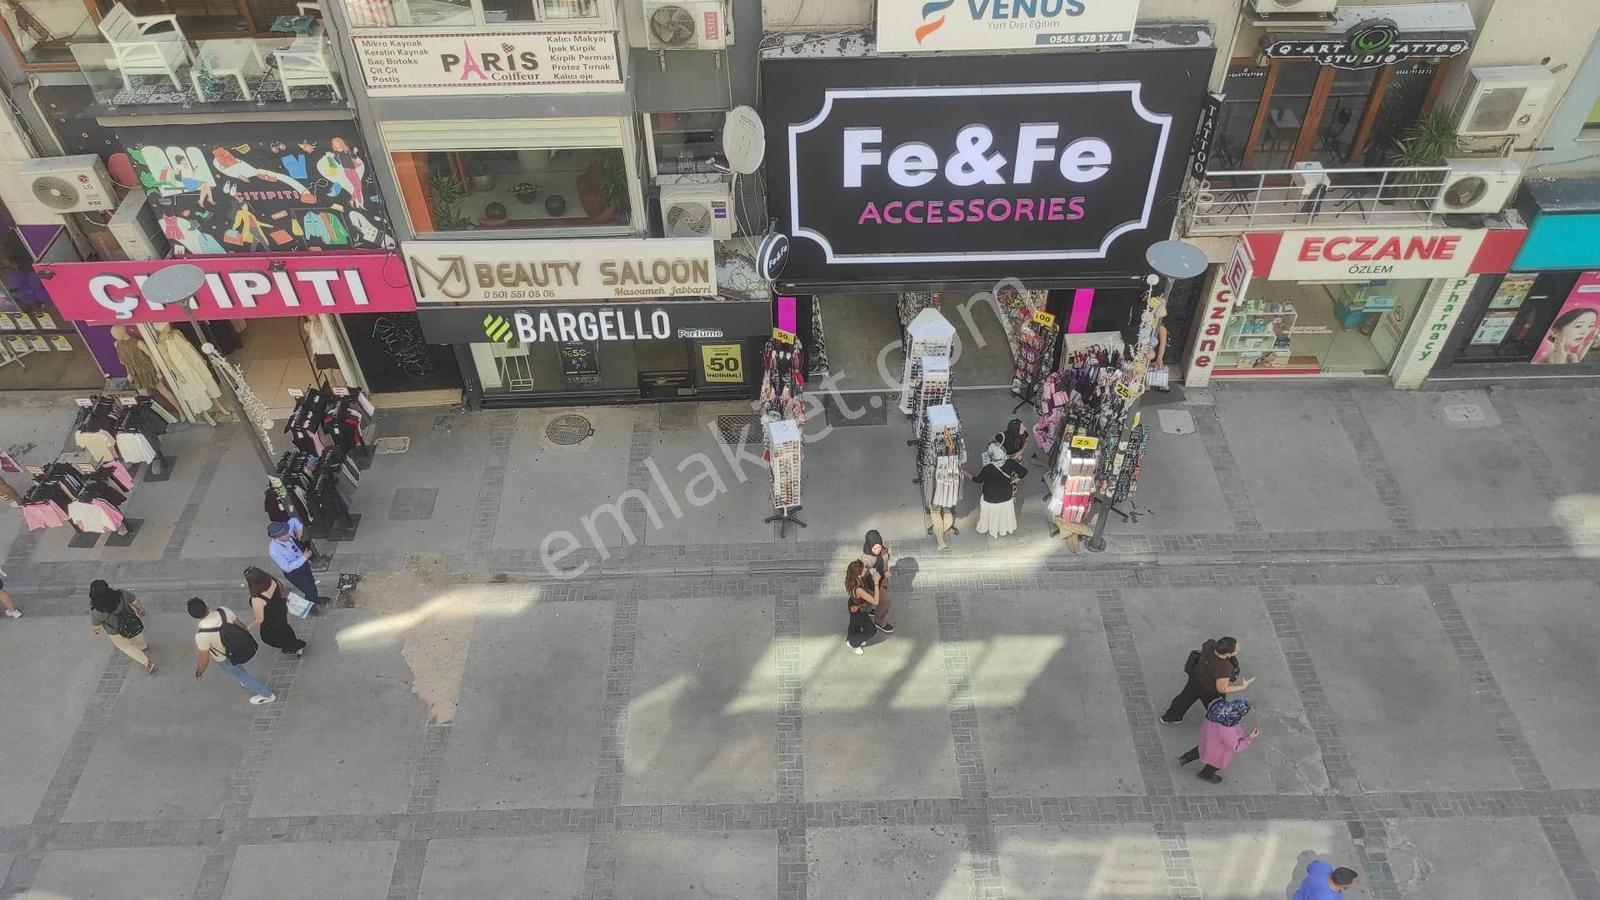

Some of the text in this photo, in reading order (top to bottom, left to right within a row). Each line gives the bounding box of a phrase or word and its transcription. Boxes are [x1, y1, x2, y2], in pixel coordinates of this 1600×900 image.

[967, 0, 1086, 20] VENUS
[987, 21, 1006, 30] Yurt
[1029, 20, 1060, 29] Eğitim
[389, 40, 422, 48] Kaynak
[573, 35, 606, 43] Makyaj
[1049, 35, 1075, 43] 0545
[1077, 34, 1096, 42] 478
[1110, 33, 1123, 41] 78
[1388, 44, 1462, 53] TATTOO
[491, 71, 540, 81] Coiffeur
[1195, 104, 1217, 173] TATTOO
[843, 122, 1113, 188] Fe&Fe
[857, 196, 1086, 225] ACCESSORIES
[1297, 235, 1462, 262] ECZANE
[768, 244, 788, 270] Fe&Fe
[474, 257, 710, 288] BEAUTY SALOON
[1231, 258, 1243, 291] E
[1348, 264, 1394, 274] ÖZLEM
[88, 268, 370, 319] ÇIPITI
[484, 290, 491, 299] 0
[511, 290, 526, 298] 551
[614, 286, 712, 296] Masoumeh Jabbarri
[514, 308, 671, 343] BARGELLO
[677, 329, 724, 339] Perfume
